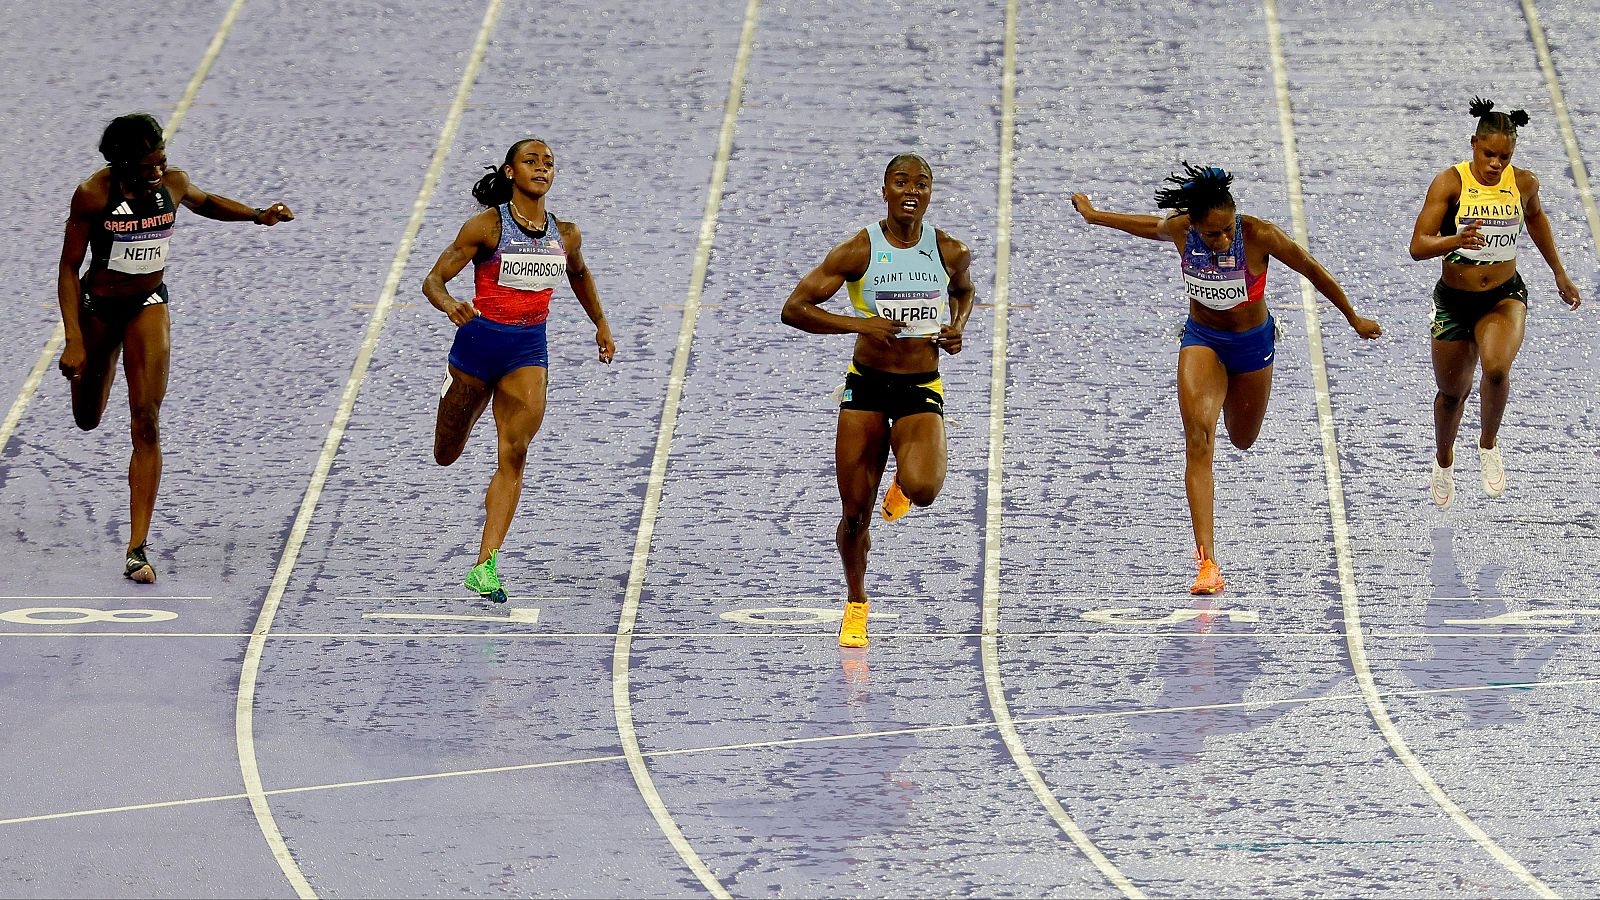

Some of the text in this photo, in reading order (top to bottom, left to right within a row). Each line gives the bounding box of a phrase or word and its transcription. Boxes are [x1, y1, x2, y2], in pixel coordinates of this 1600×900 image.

[1463, 204, 1520, 217] JAMAICA
[104, 211, 175, 232] GREAT BRITAIN
[1485, 232, 1518, 248] YTON
[123, 246, 161, 261] NEITA
[502, 260, 566, 277] RICHARDSON
[873, 271, 939, 286] SAINT LUCIA
[1185, 281, 1246, 300] JEFFERSON
[882, 306, 938, 321] ALFRED
[0, 607, 179, 625] 8
[1079, 608, 1260, 625] 5
